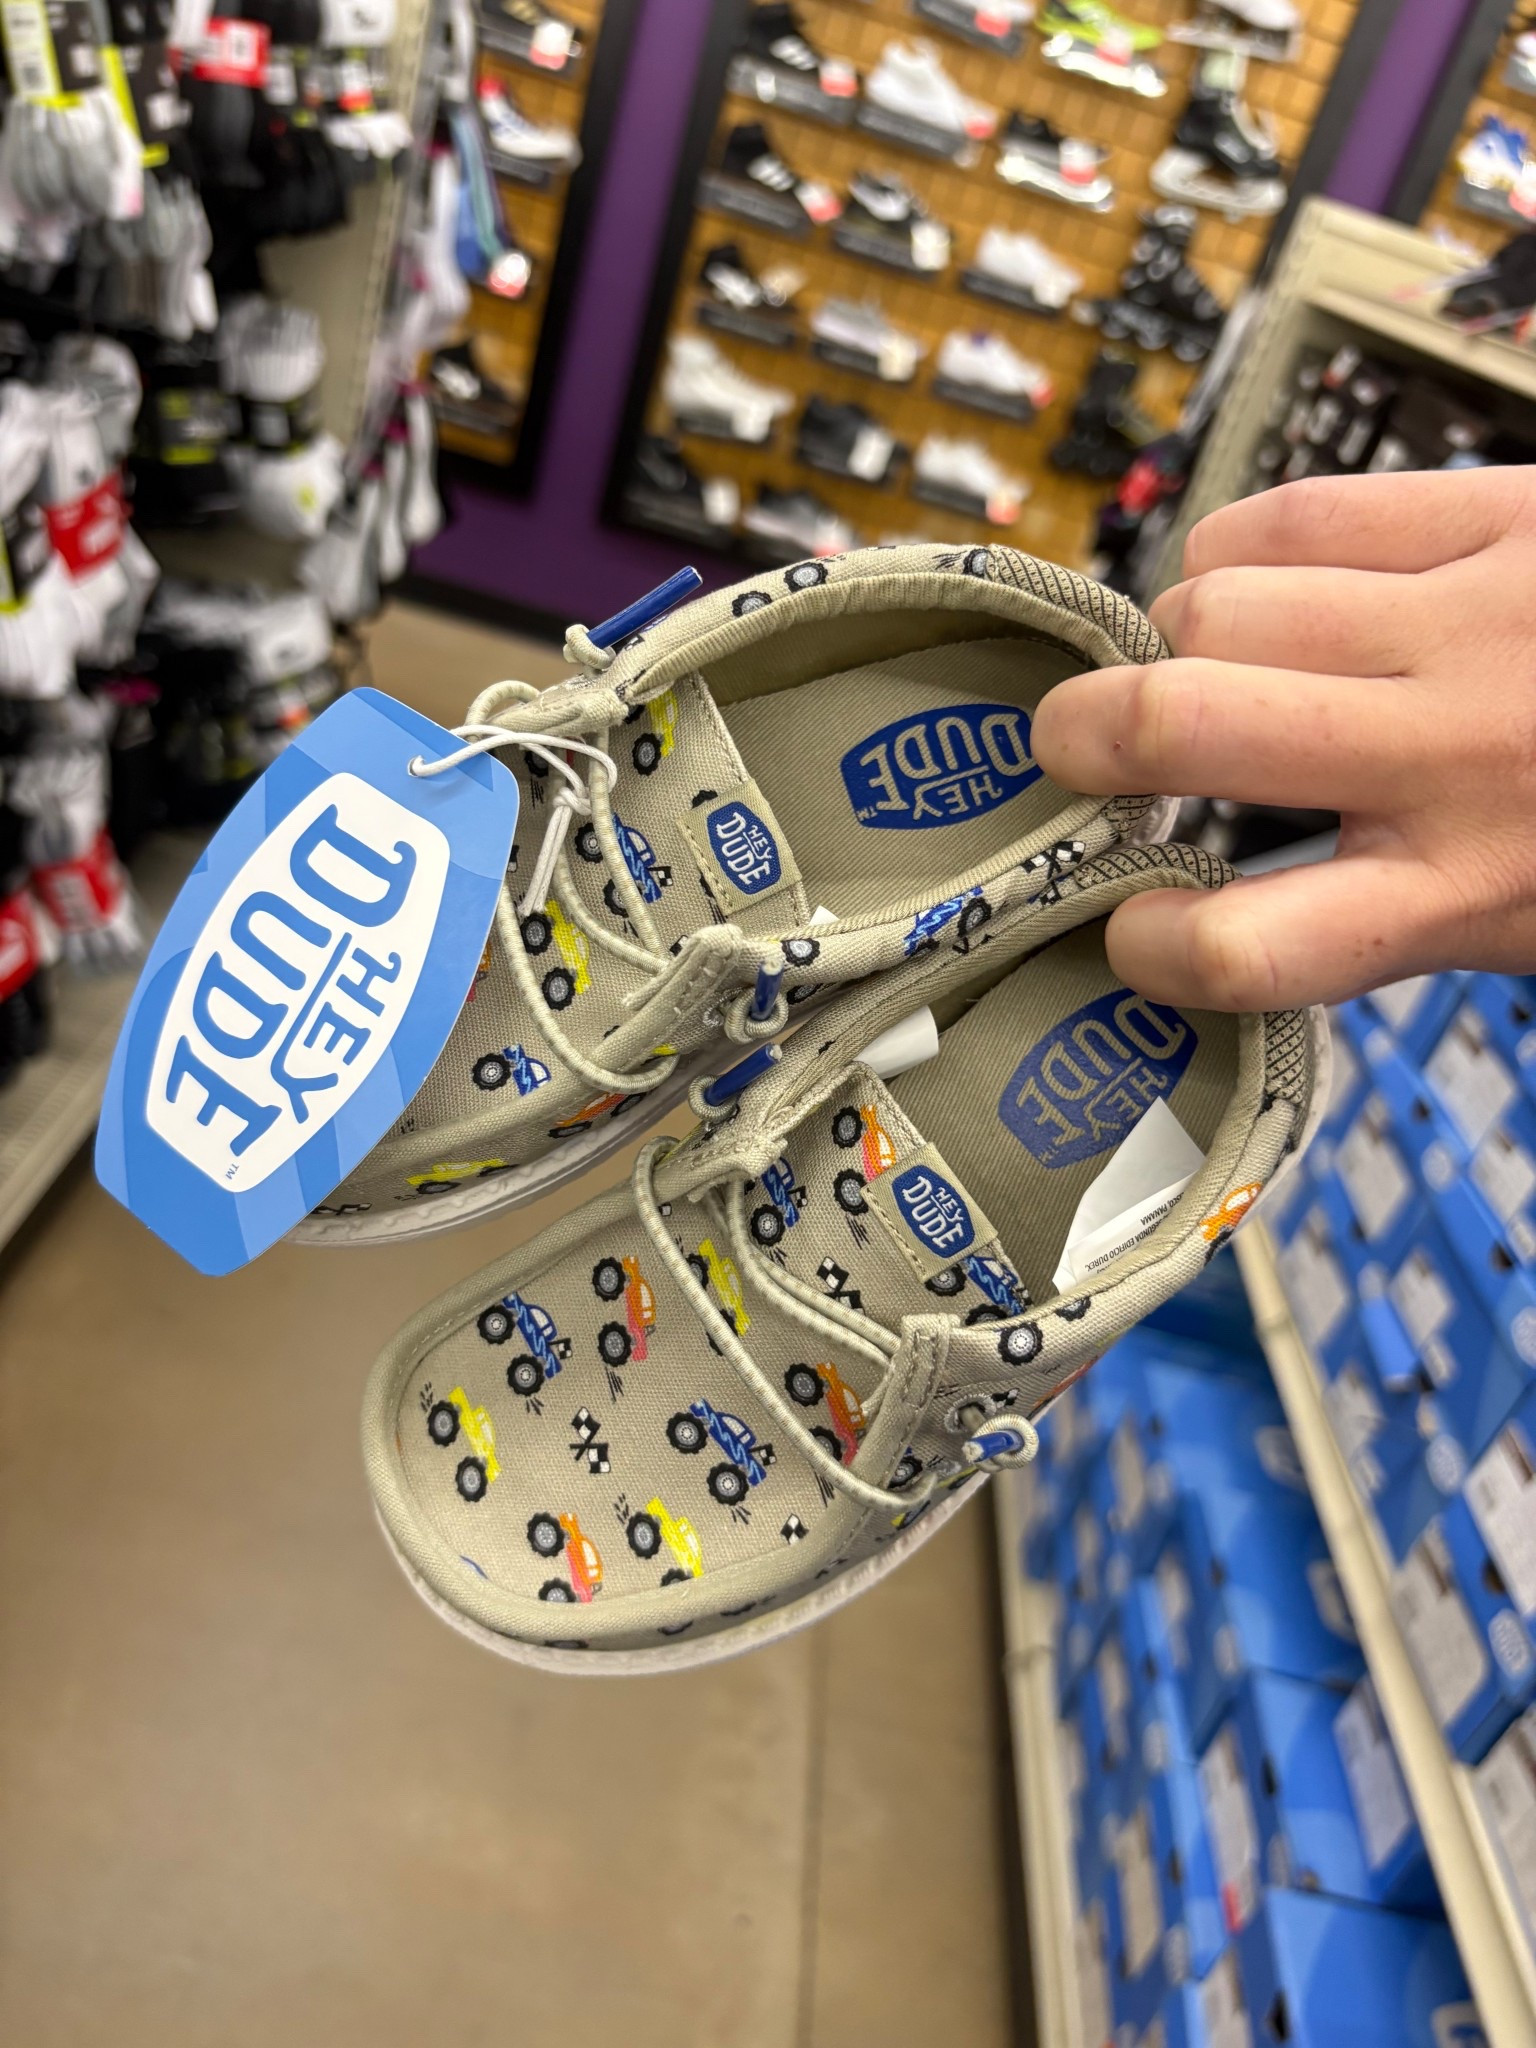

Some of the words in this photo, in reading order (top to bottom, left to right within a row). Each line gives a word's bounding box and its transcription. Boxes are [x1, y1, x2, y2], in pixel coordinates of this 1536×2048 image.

[860, 713, 1039, 811] DUDE
[913, 765, 1003, 820] HEY
[716, 812, 770, 885] DUDE
[743, 825, 772, 860] HEY
[166, 804, 417, 1157] DUDE
[270, 932, 402, 1125] HEY
[1016, 995, 1187, 1146] DUDE
[1083, 1057, 1168, 1141] HEY
[225, 1163, 240, 1181] TM
[931, 1187, 964, 1222] HEY
[902, 1176, 964, 1248] DUDE
[1109, 1237, 1135, 1259] EDIFICIO
[1140, 1203, 1168, 1226] PANAMA
